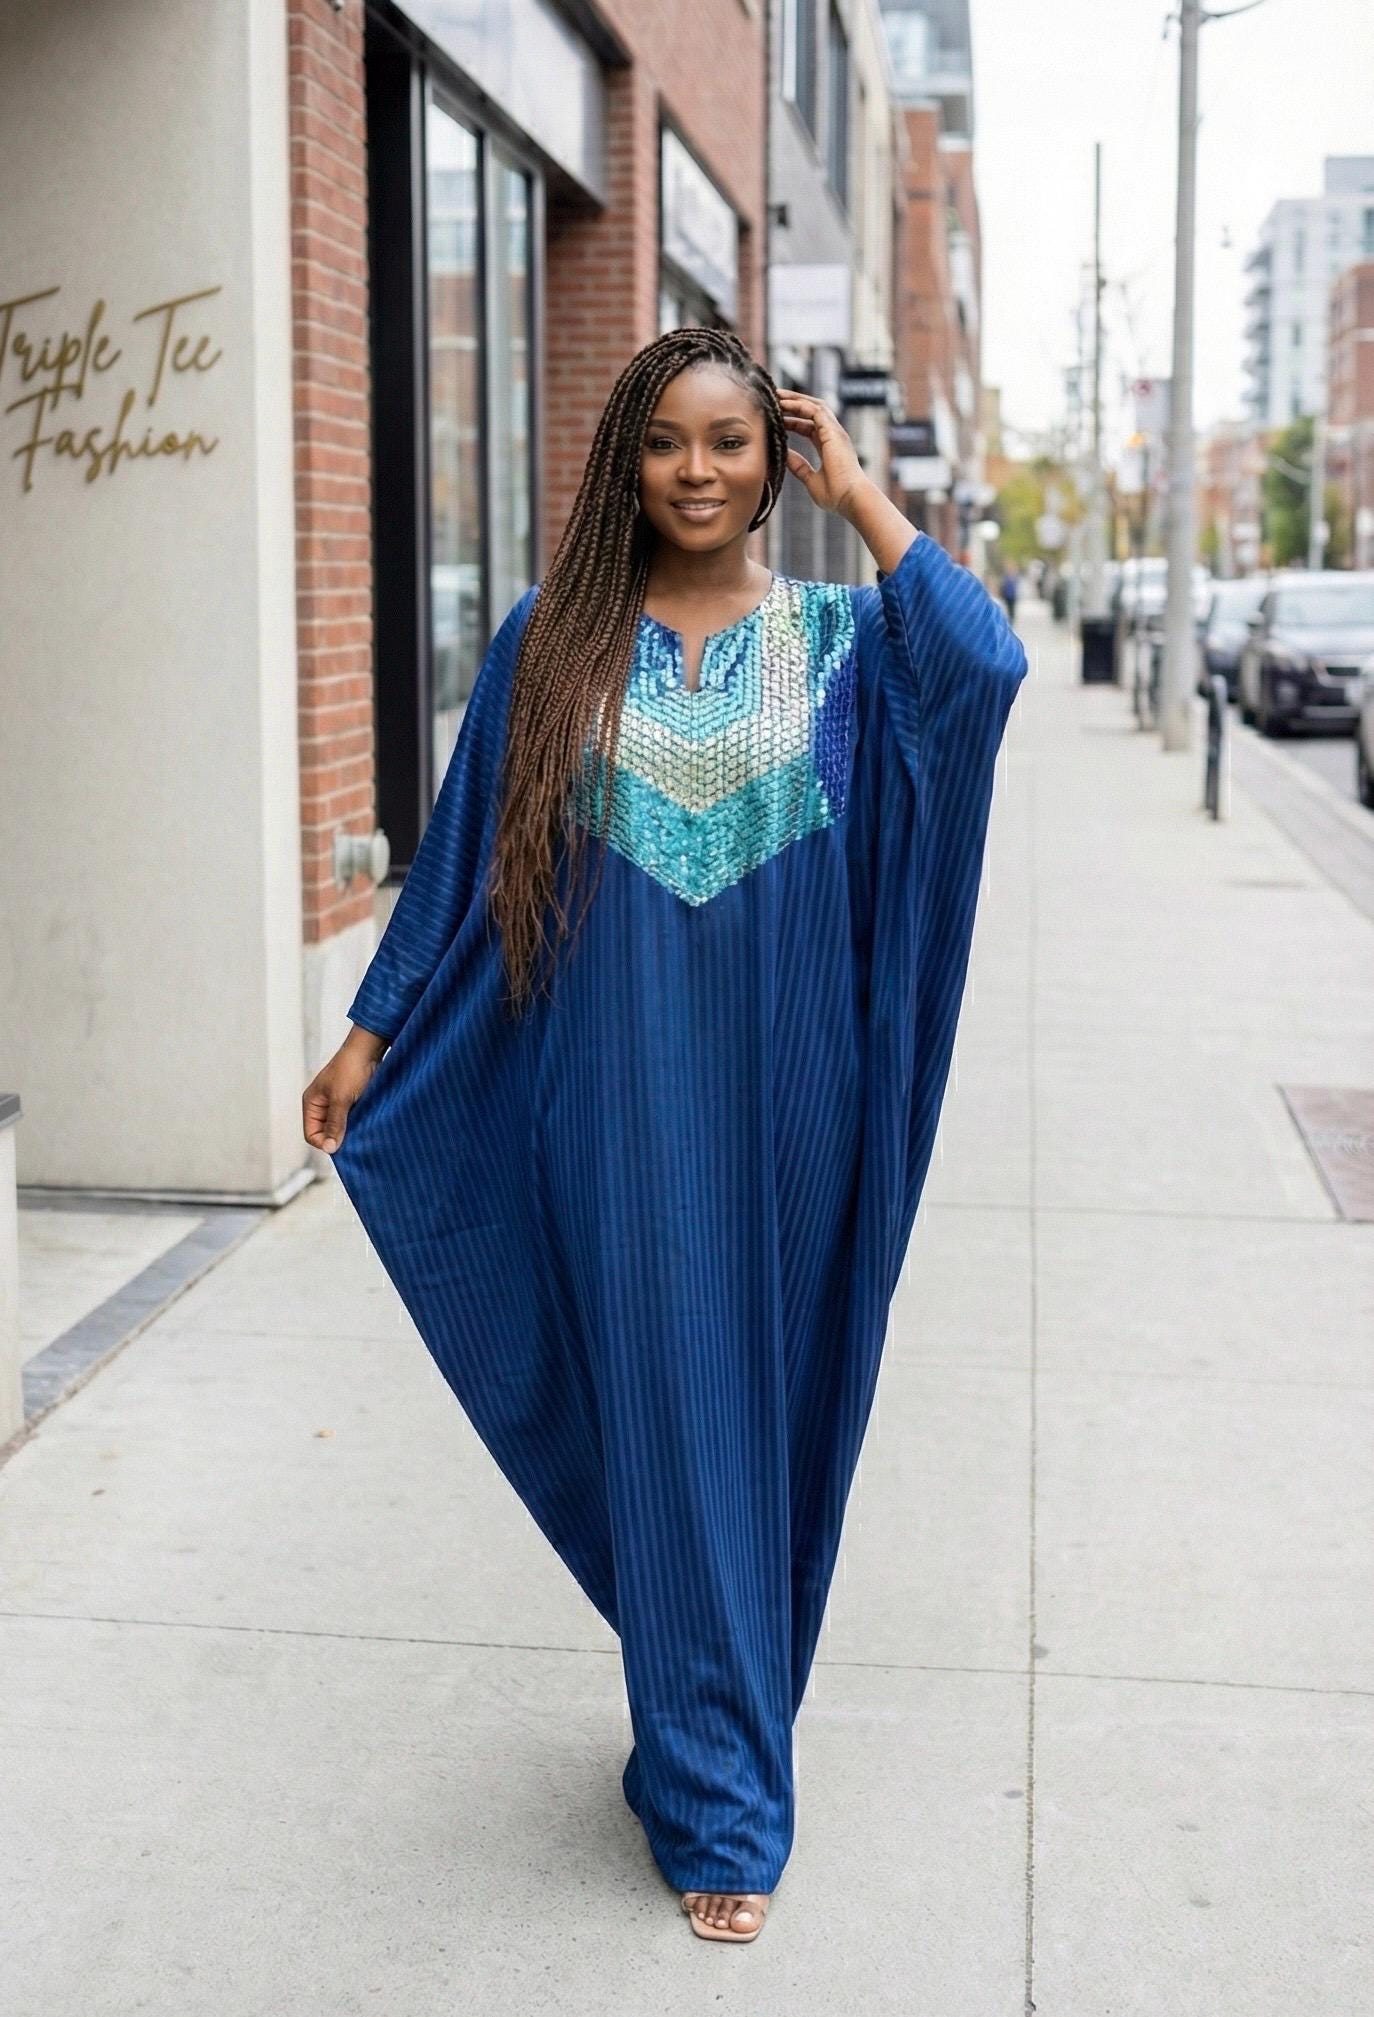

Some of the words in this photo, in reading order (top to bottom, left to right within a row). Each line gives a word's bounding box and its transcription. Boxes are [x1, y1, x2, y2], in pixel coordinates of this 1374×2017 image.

[0, 286, 122, 410] Triple
[133, 285, 222, 407] Tee
[5, 385, 219, 493] Fashion
